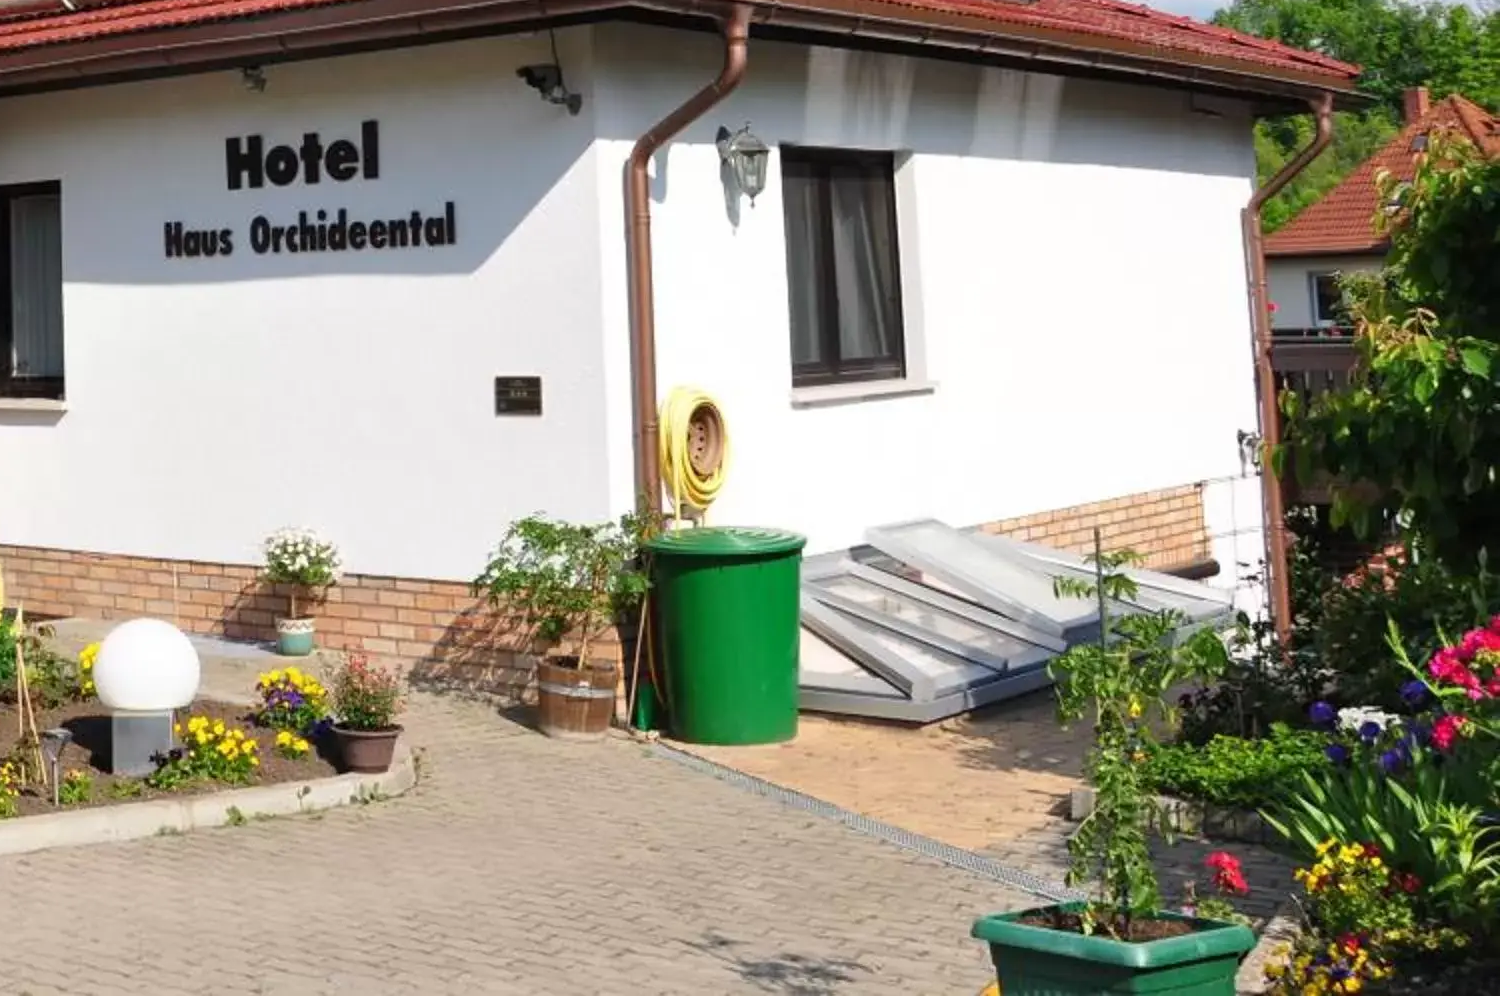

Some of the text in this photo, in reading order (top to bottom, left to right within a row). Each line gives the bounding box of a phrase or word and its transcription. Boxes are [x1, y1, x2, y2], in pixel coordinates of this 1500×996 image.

[226, 120, 380, 190] Hotel
[164, 201, 457, 258] Haus Orchideental
